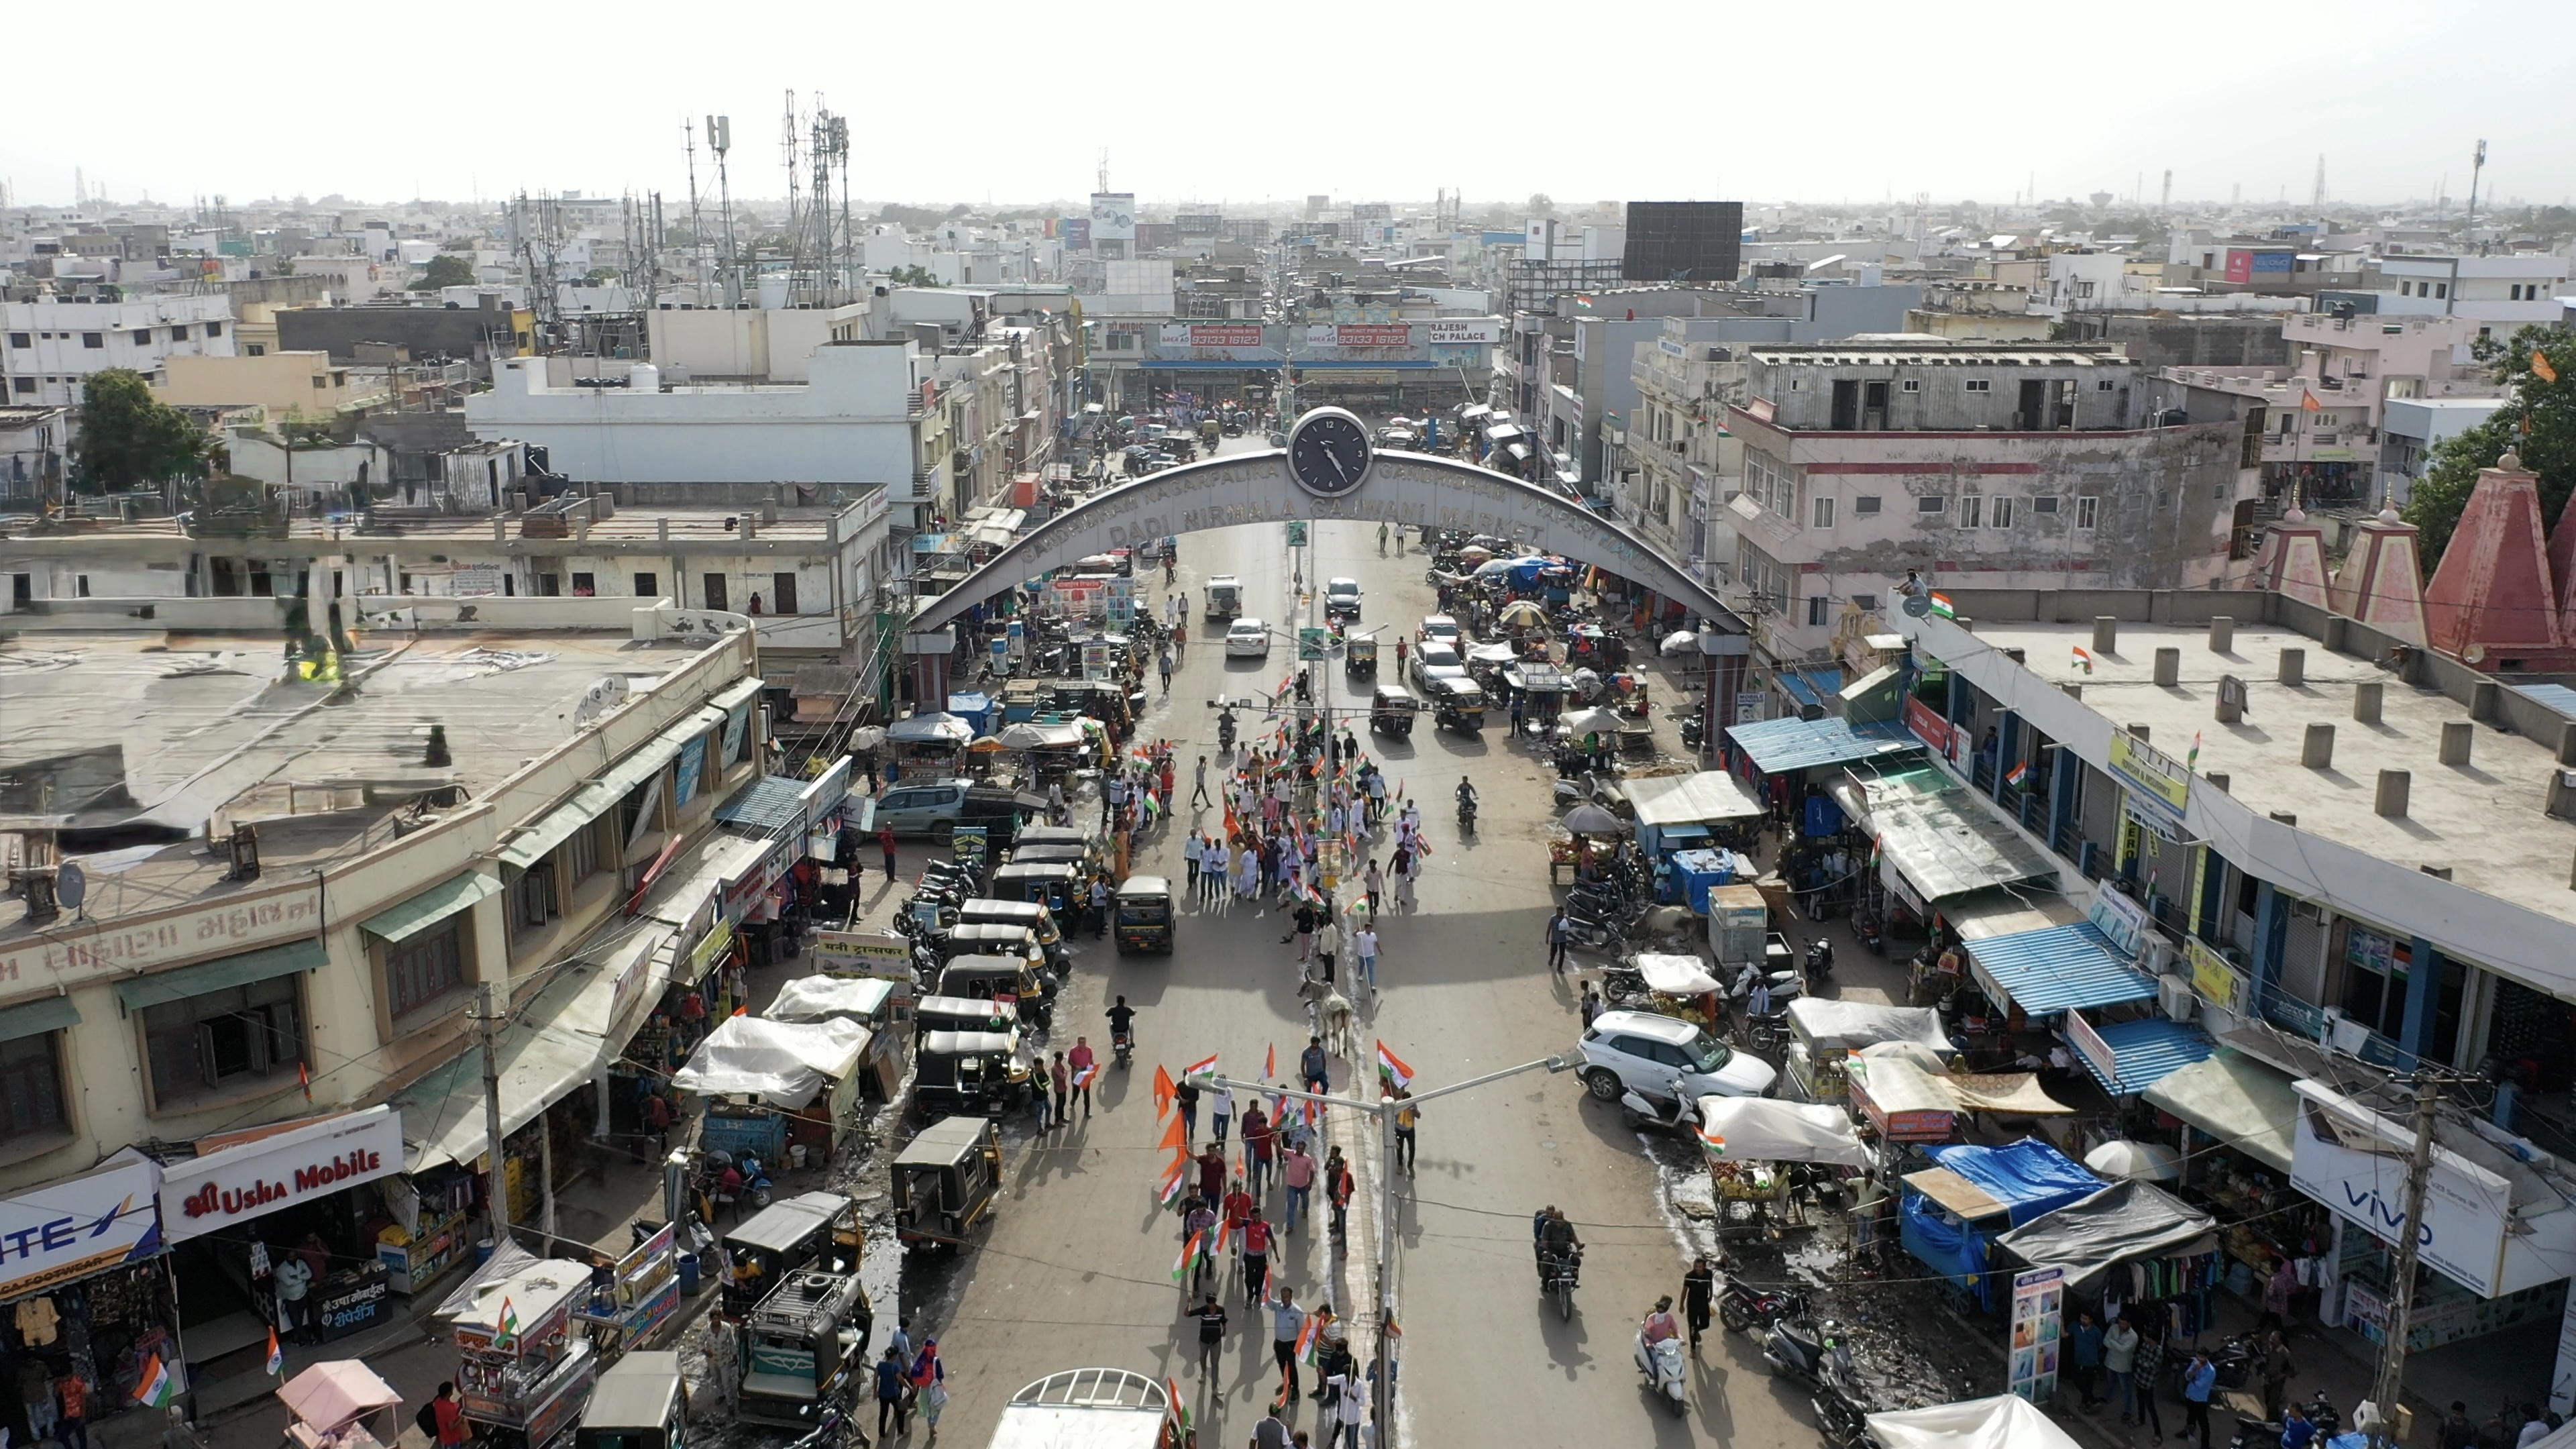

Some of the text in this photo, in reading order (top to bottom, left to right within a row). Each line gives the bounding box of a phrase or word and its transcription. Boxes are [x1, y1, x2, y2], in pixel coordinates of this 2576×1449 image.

[1191, 336, 1259, 344] 93133 16123
[1338, 336, 1406, 344] 93133 16123
[1450, 333, 1486, 341] PALACE
[1326, 421, 1334, 429] 12
[1297, 451, 1303, 459] 9
[1357, 450, 1364, 458] 3
[1020, 461, 1280, 564] GANDHIDHAM NAGARPALIKA
[1109, 498, 1545, 547] DADI NIRMALA GAJWANI MARKET
[1379, 462, 1509, 502] GANDHIDHAM
[1598, 534, 1667, 588] MANDAL
[824, 942, 904, 956] मनी ट्रान्सफर
[2446, 1188, 2467, 1204] Series
[25, 1257, 103, 1287] FOOTWEAR
